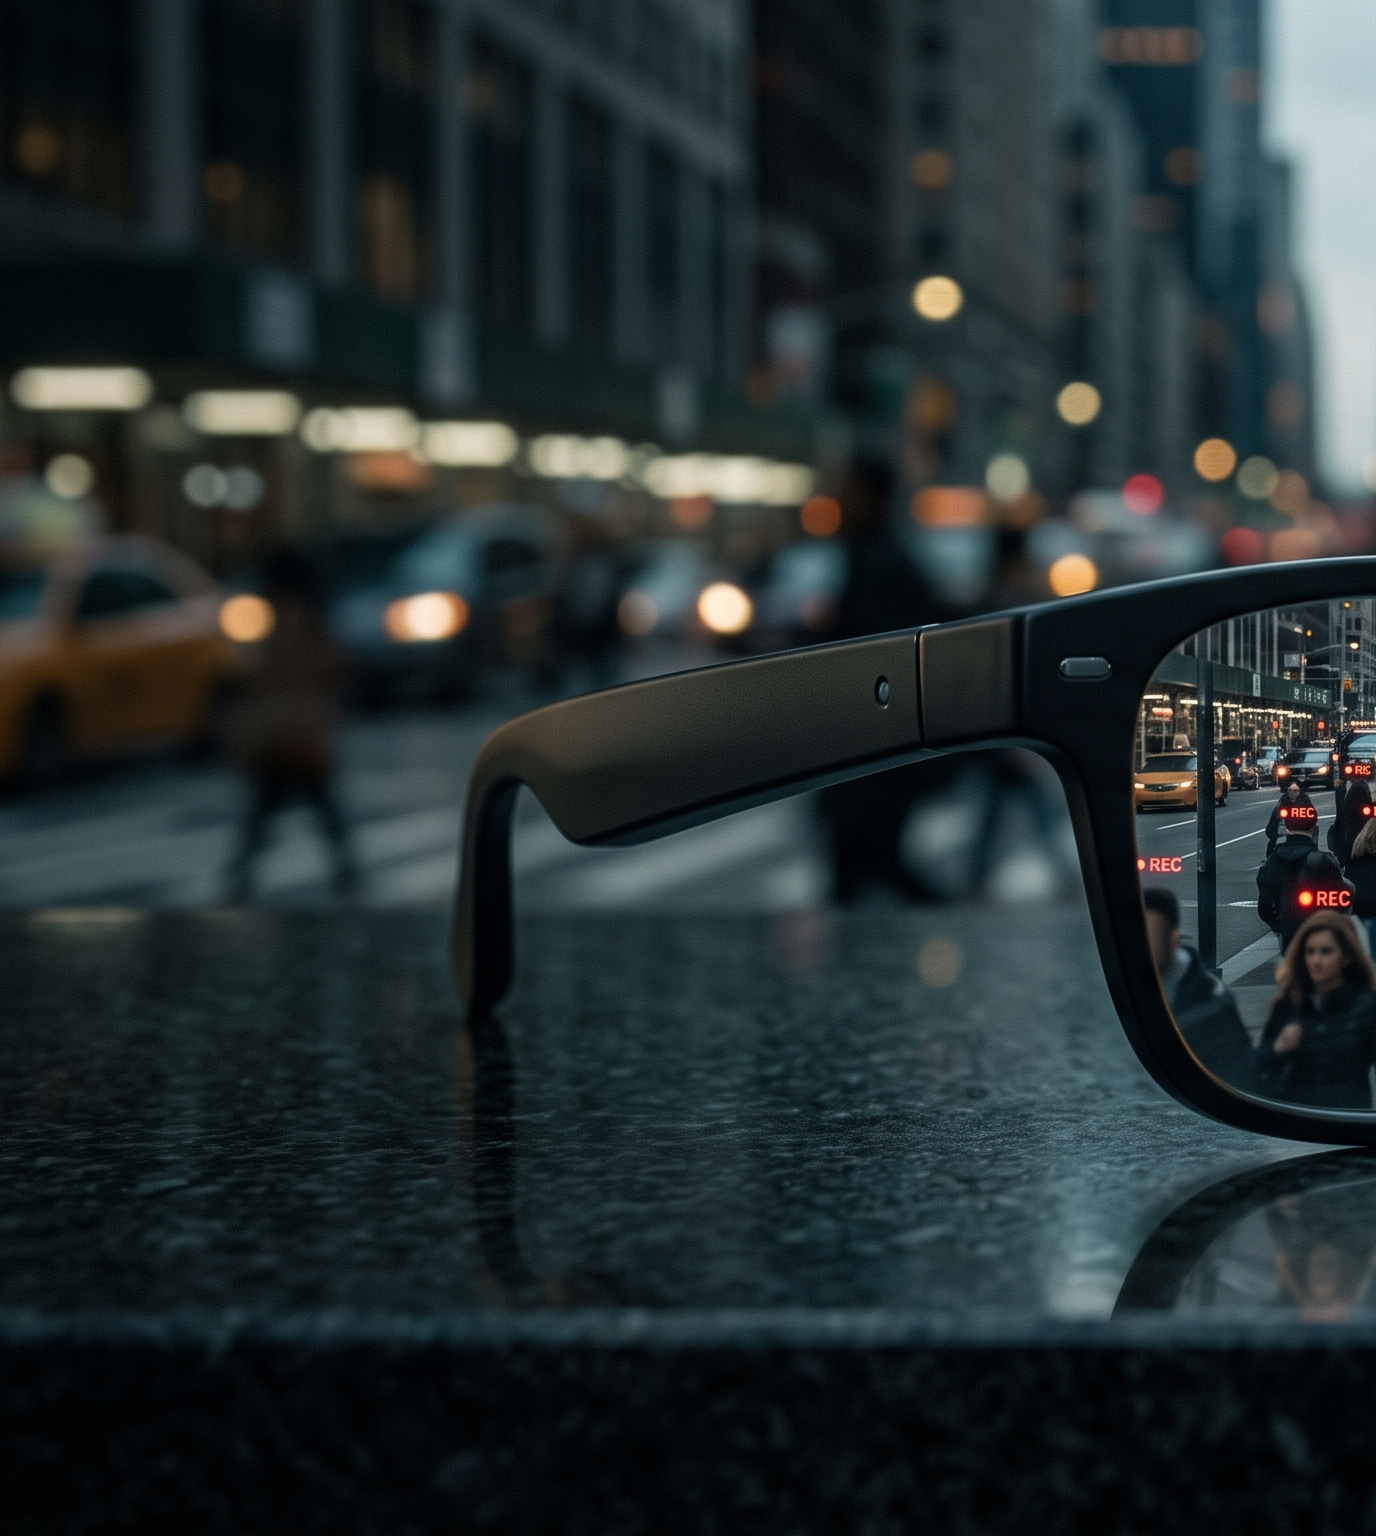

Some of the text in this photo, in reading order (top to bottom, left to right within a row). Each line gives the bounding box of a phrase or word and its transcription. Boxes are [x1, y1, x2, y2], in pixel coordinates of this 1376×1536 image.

[1290, 807, 1315, 818] REC
[1149, 857, 1182, 872] REC
[1316, 890, 1351, 907] REC
